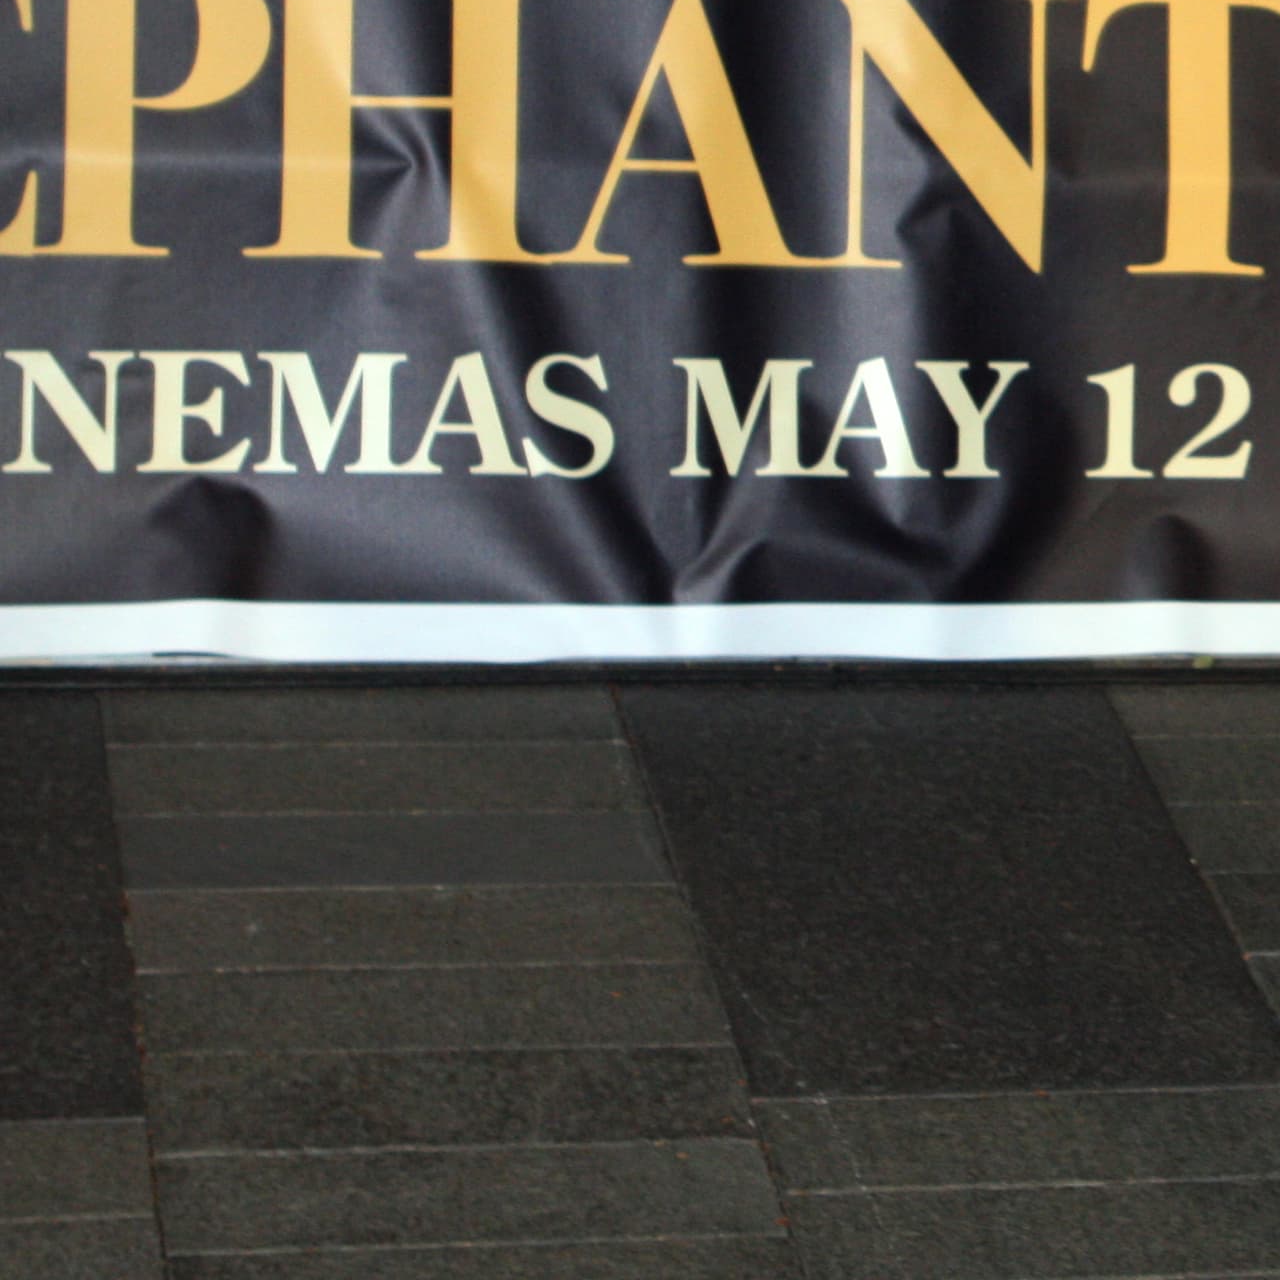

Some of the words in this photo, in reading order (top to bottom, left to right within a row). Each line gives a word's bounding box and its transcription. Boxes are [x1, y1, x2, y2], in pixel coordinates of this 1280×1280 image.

[3, 350, 615, 478] NEMAS
[670, 357, 1029, 478] MAY
[1085, 363, 1252, 479] 12
